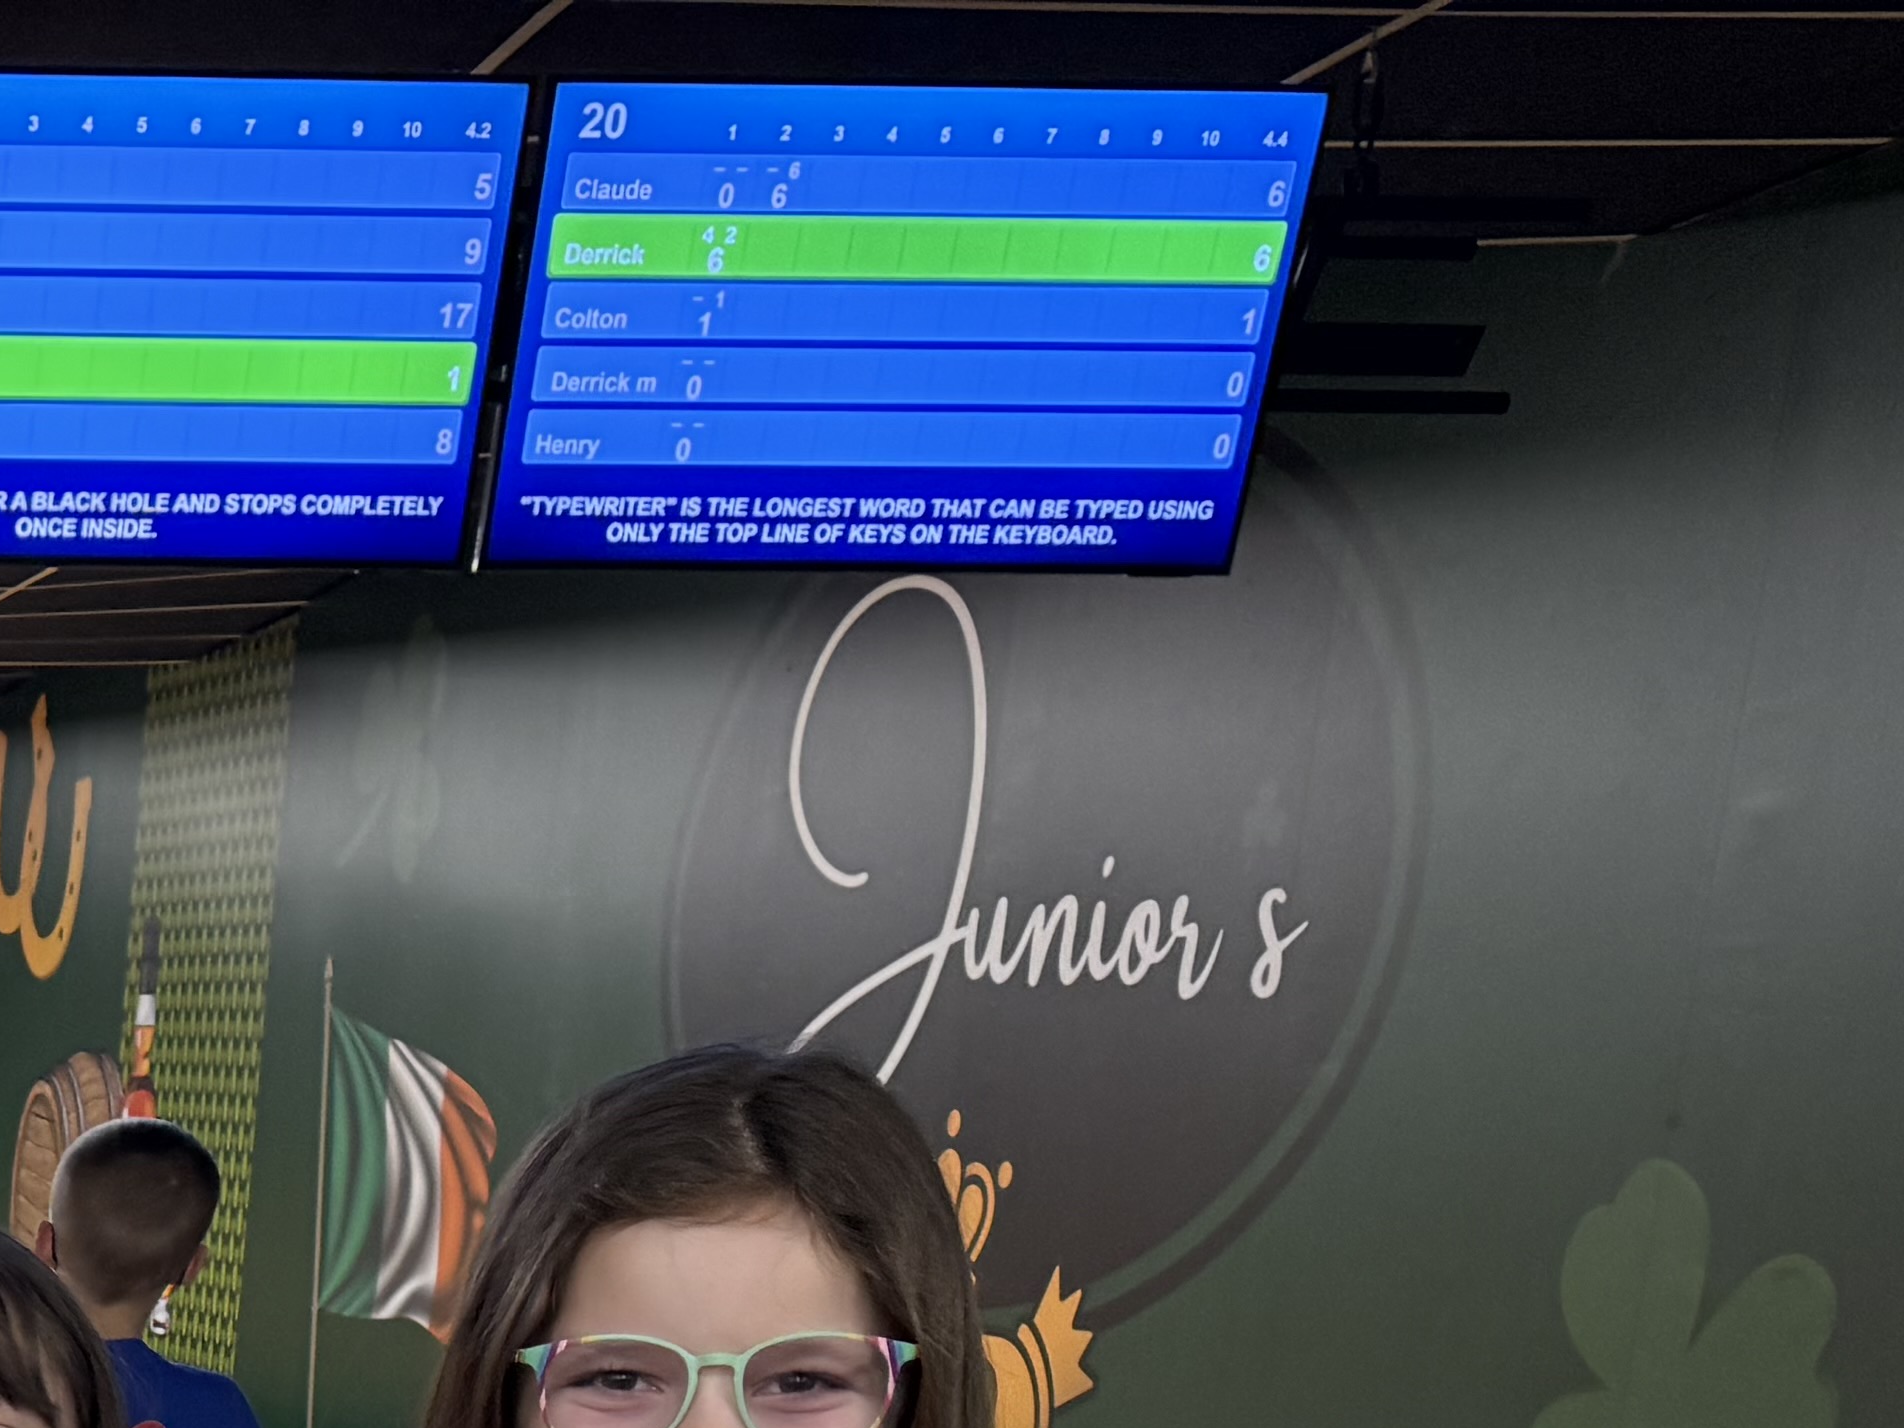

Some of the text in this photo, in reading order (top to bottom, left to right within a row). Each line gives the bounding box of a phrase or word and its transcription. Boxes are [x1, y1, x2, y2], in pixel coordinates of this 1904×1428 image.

[579, 103, 627, 140] 20
[472, 173, 491, 200] 5
[574, 177, 653, 202] Claude
[1267, 180, 1287, 208] 6
[463, 238, 482, 266] 9
[564, 242, 645, 267] Derrick
[1254, 244, 1272, 271] 6
[439, 303, 473, 330] 17
[555, 307, 628, 331] Colton
[1241, 308, 1256, 335] 1
[446, 366, 461, 392] 1
[550, 370, 657, 395] Derrick m
[1226, 371, 1244, 398] 0
[435, 429, 452, 456] 8
[535, 432, 600, 460] Henry
[1213, 433, 1230, 461] 0
[10, 491, 27, 511] A
[31, 491, 106, 512] BLACK
[110, 492, 170, 514] HOLE
[172, 493, 220, 514] AND
[224, 493, 297, 516] STOPS
[300, 494, 444, 516] COMPLETELY
[680, 497, 701, 517] IS
[707, 497, 750, 518] THE
[753, 498, 856, 518] LONGEST
[859, 498, 926, 519] WORD
[931, 498, 987, 519] THAT
[989, 499, 1035, 519] CAN
[1042, 499, 1070, 519] BE
[1074, 499, 1143, 520] TYPED
[1147, 500, 1214, 521] USING
[15, 517, 157, 539] ONCE INSIDE.
[606, 521, 1117, 545] ONLY THE TOP LINE OF KEYS ON THE KEYBOARD.
